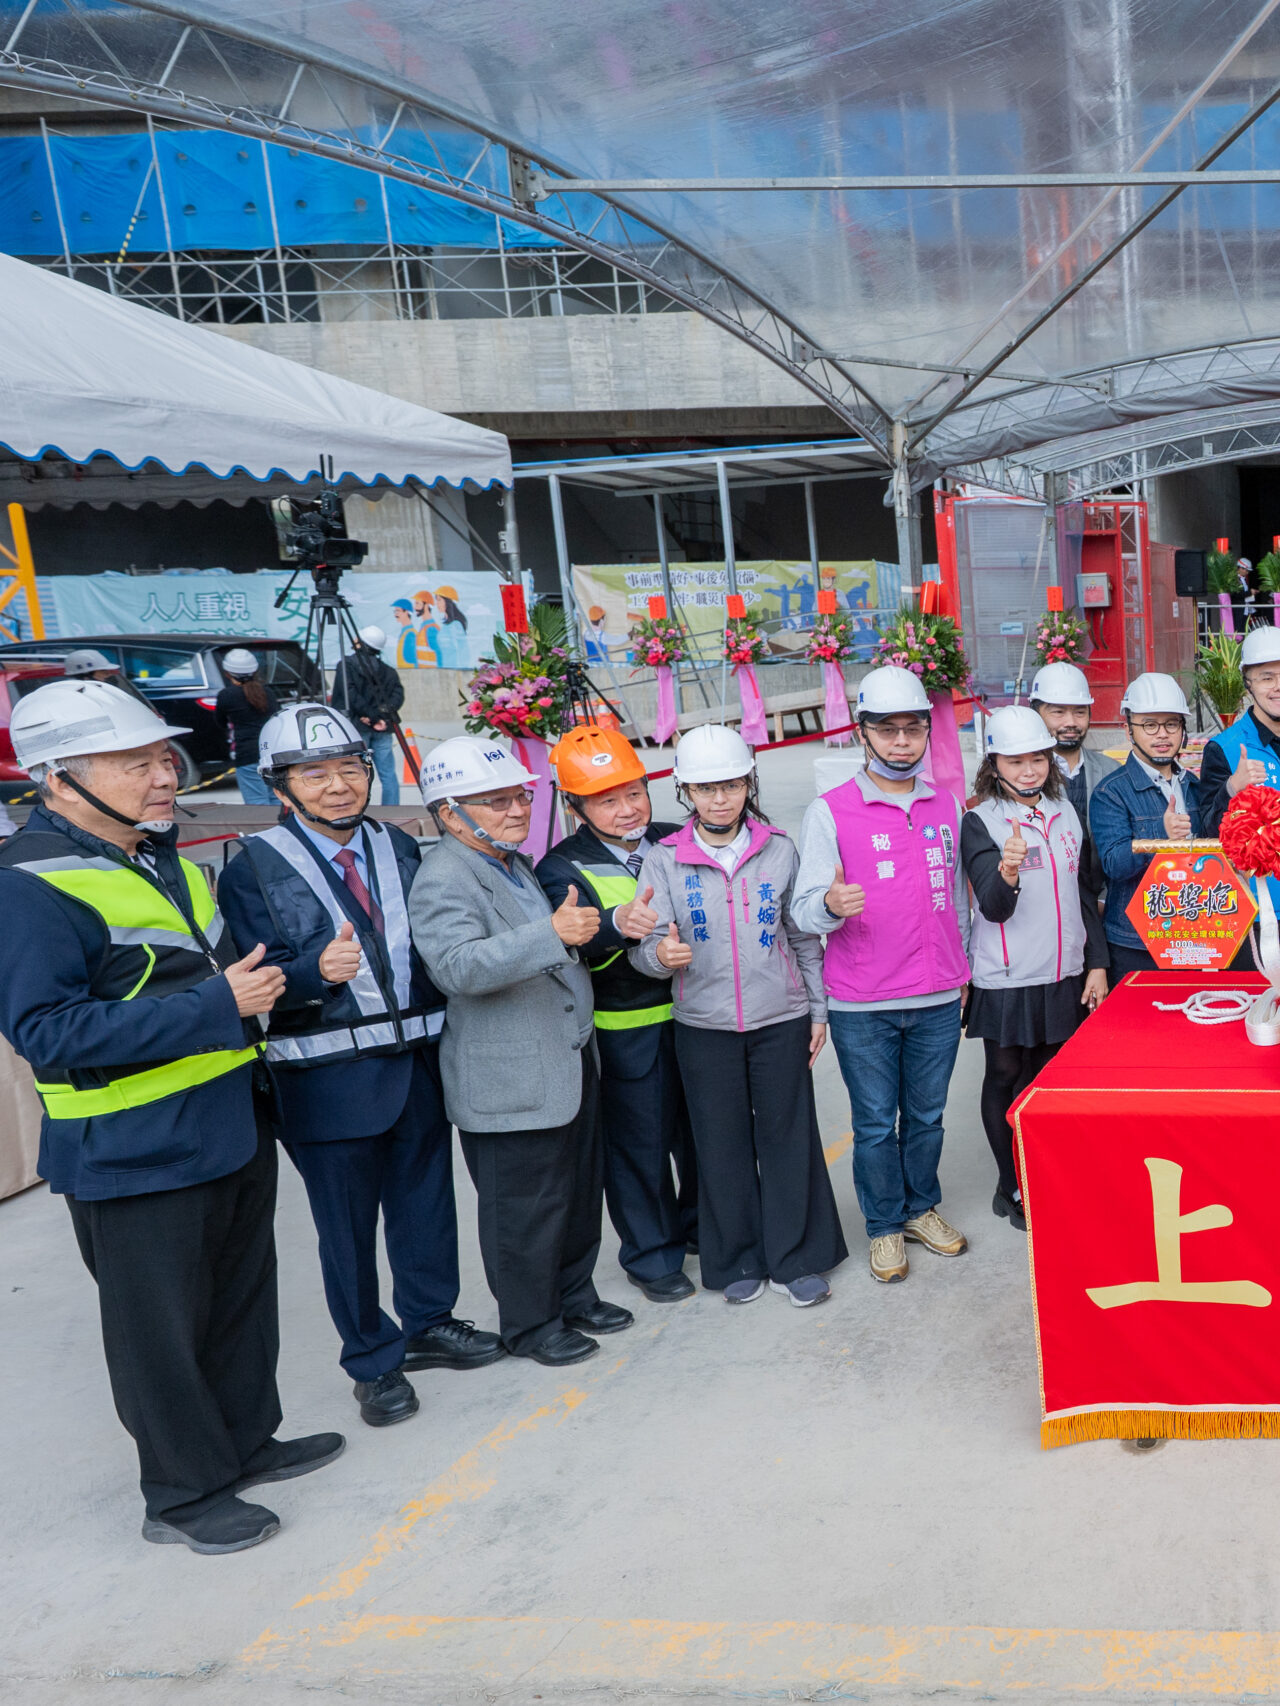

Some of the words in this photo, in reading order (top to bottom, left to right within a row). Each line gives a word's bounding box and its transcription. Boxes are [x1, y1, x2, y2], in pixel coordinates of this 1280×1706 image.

[140, 592, 249, 621] 人人重視
[871, 833, 896, 880] 秘書
[925, 847, 947, 912] 張碩芳
[684, 874, 711, 943] 服務團隊
[757, 882, 776, 949] 黃婉如
